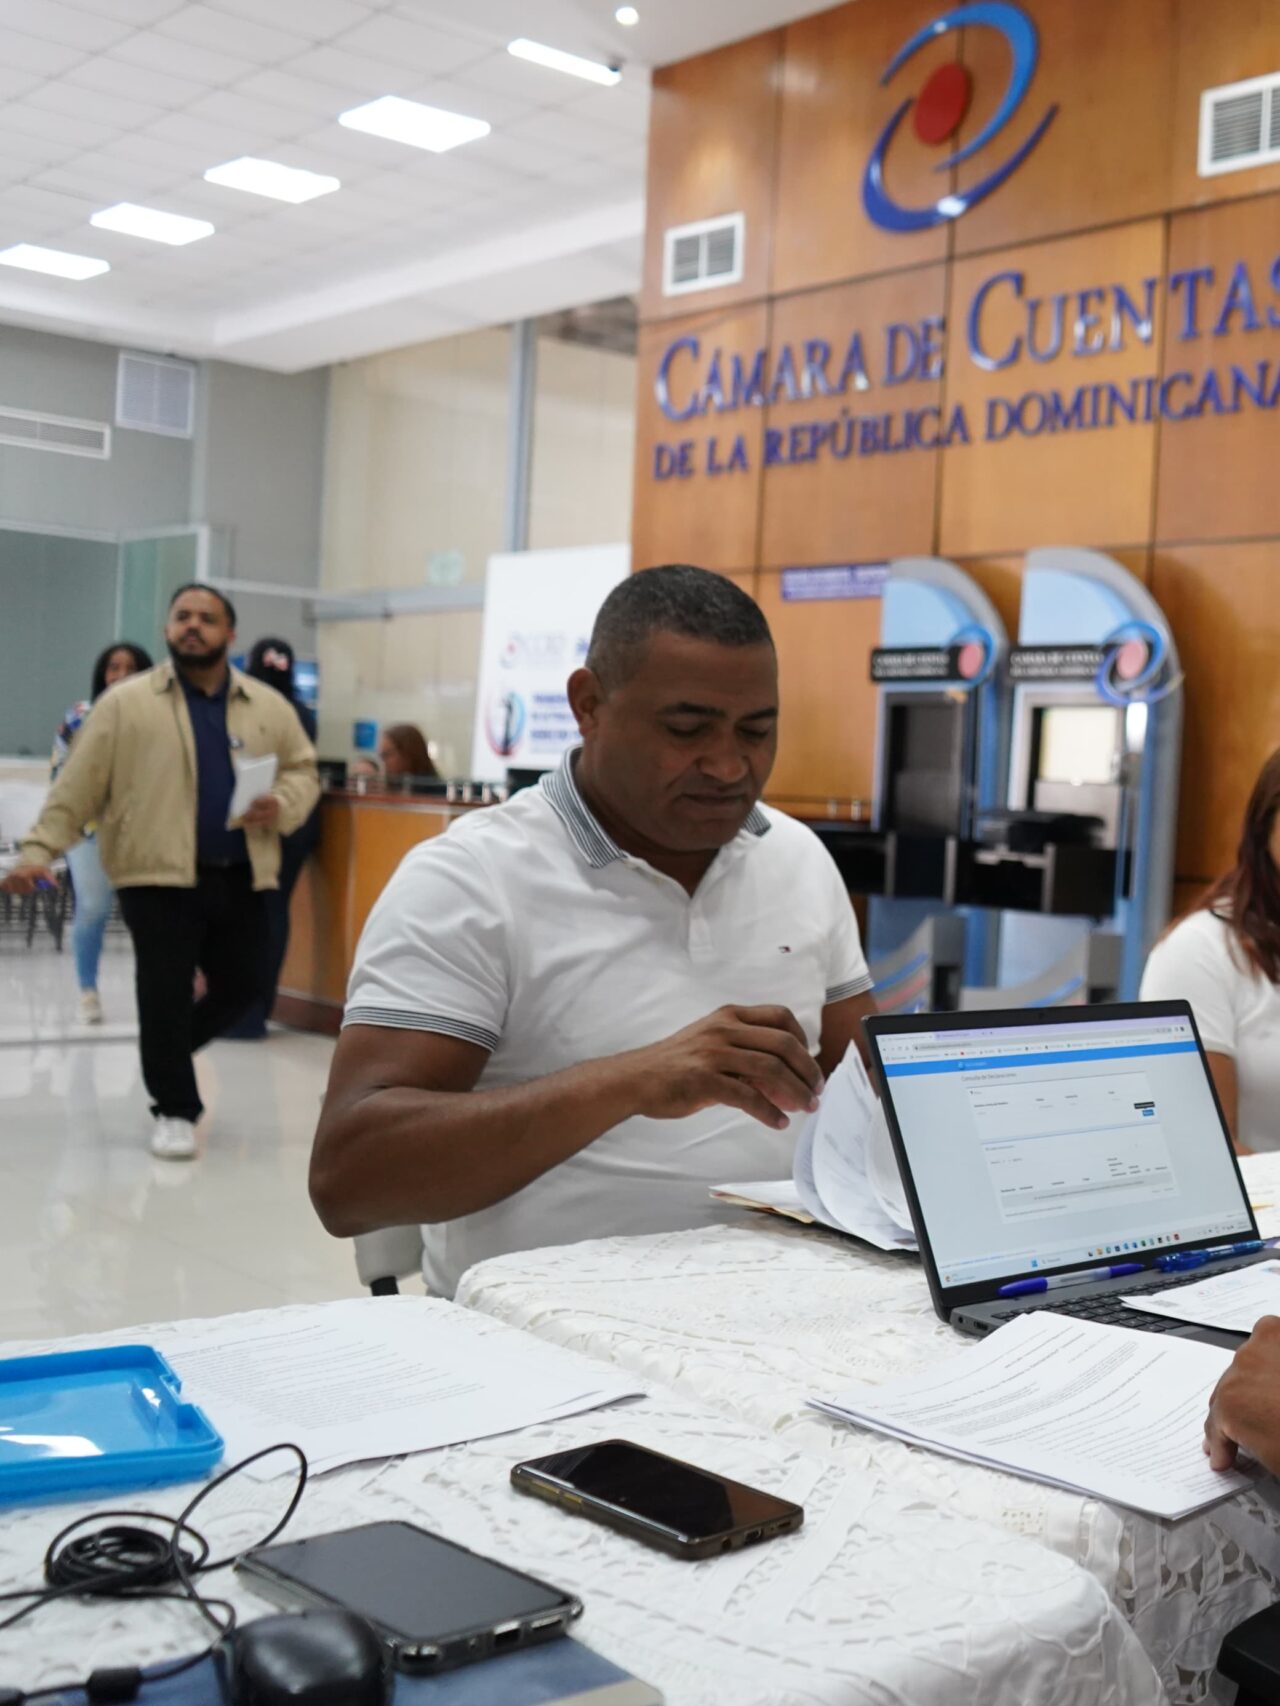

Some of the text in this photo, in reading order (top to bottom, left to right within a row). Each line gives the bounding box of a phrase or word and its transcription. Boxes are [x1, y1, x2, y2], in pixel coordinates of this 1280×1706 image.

[881, 316, 946, 386] DE
[653, 440, 694, 480] DE
[706, 433, 749, 476] LA
[763, 401, 972, 467] REPÚBLICA
